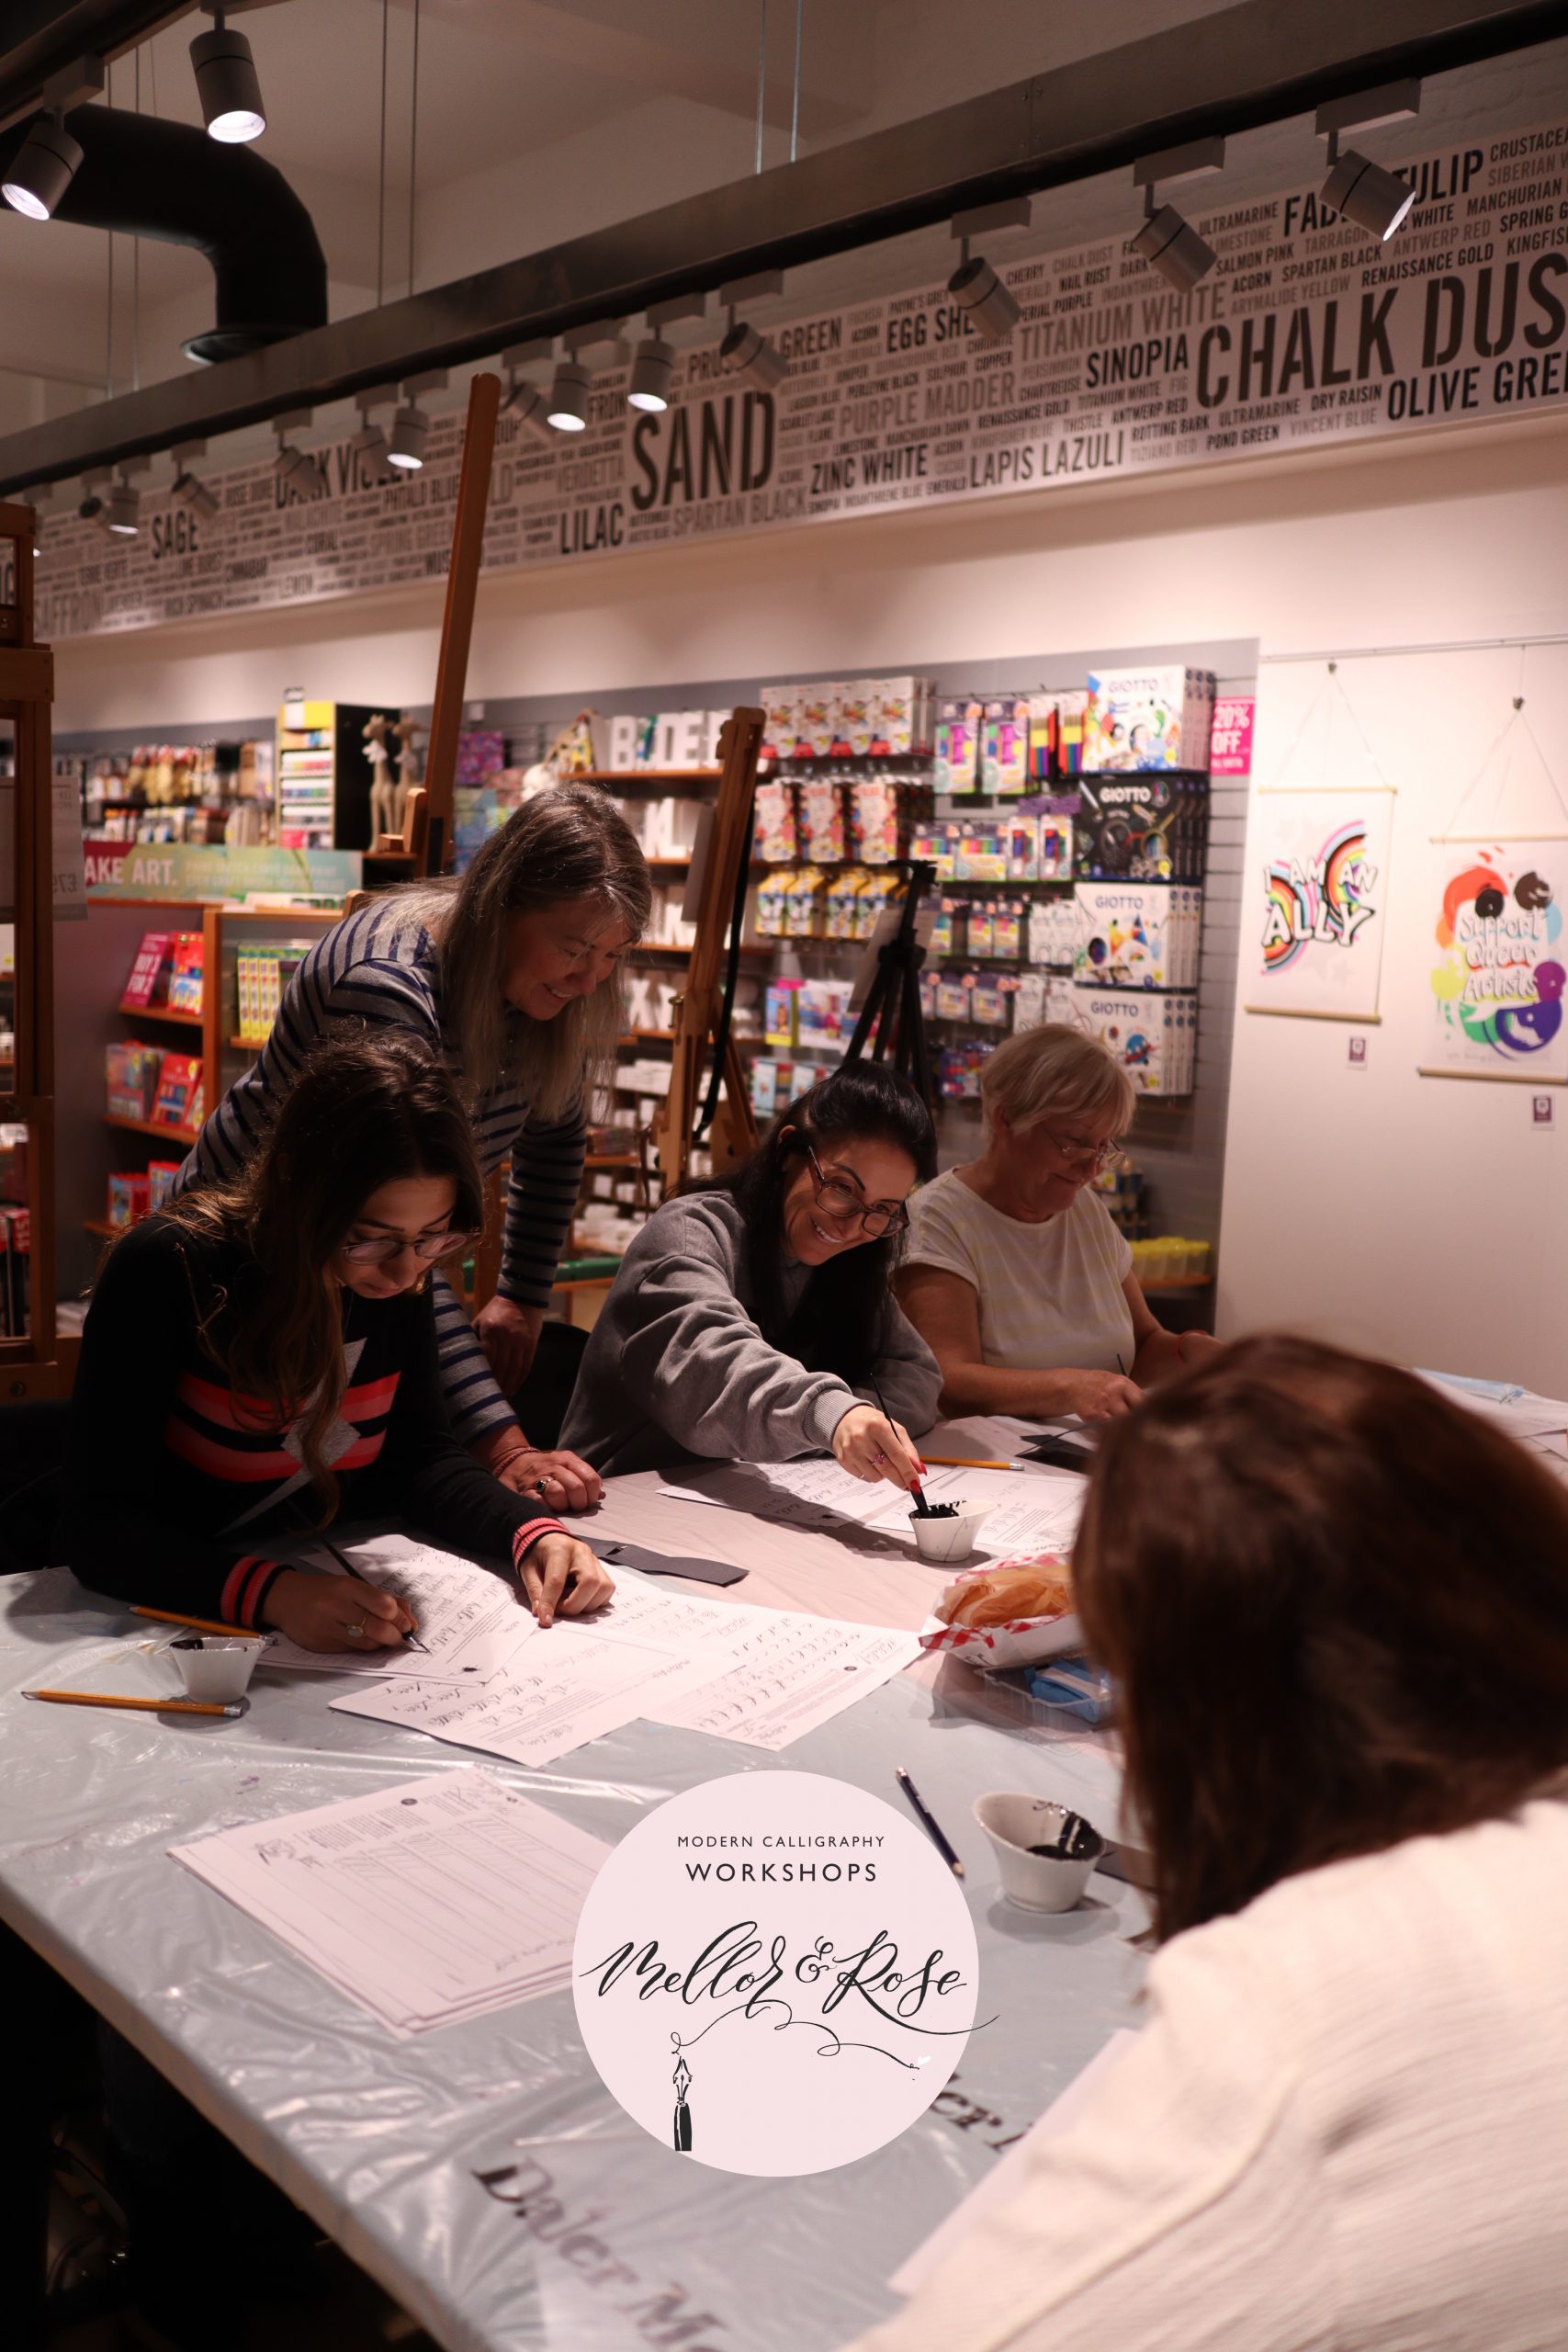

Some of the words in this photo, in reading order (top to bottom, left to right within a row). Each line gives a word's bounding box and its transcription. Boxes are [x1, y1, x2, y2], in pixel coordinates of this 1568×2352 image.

[1487, 153, 1556, 187] SIBERIAN
[1467, 177, 1562, 217] MANCHURIAN
[1199, 201, 1280, 237] ULTRAMARINE
[1412, 203, 1456, 230] WHITE
[1499, 205, 1554, 233] SPRING
[1393, 225, 1460, 257] ANTWERP
[1462, 219, 1492, 243] RED
[1215, 250, 1263, 277] SALMON
[1265, 243, 1294, 265] PINK
[1282, 254, 1337, 283] SPARTAN
[1340, 244, 1382, 274] BLACK
[1361, 252, 1454, 288] RENAISSANCE
[1458, 243, 1495, 266] GOLD
[1232, 270, 1272, 294] ACORN
[781, 316, 842, 361] GREEN
[886, 313, 928, 355] EGG
[1020, 302, 1134, 362] TITANIUM
[1141, 280, 1227, 334] WHITE
[1085, 333, 1190, 390] SINOPIA
[1196, 287, 1399, 410] CHALK
[839, 391, 919, 438] PURPLE
[924, 371, 1016, 421] MADDER
[1311, 391, 1337, 412] DRY
[1338, 383, 1382, 407] RAISIN
[1387, 365, 1482, 422] OLIVE
[629, 390, 776, 513] SAND
[1241, 424, 1280, 447] GREEN
[810, 457, 856, 495] ZINC
[862, 443, 929, 485] WHITE
[970, 446, 1034, 489] LAPIS
[1043, 429, 1125, 478] LAZULI
[152, 509, 198, 560] SAGE
[559, 502, 626, 556] LILAC
[1108, 678, 1159, 695] GIOTTO
[1213, 705, 1250, 729] 20%
[1213, 730, 1243, 754] OFF
[1100, 786, 1152, 804] GIOTTO
[84, 855, 124, 884] AKE
[1289, 856, 1327, 888] AM
[1337, 859, 1379, 893] AN
[1095, 895, 1144, 910] GIOTTO
[1260, 900, 1376, 948] ALLY
[1464, 941, 1537, 971] Queer
[1461, 968, 1539, 1002] Artists
[1090, 1001, 1139, 1017] GIOTTO
